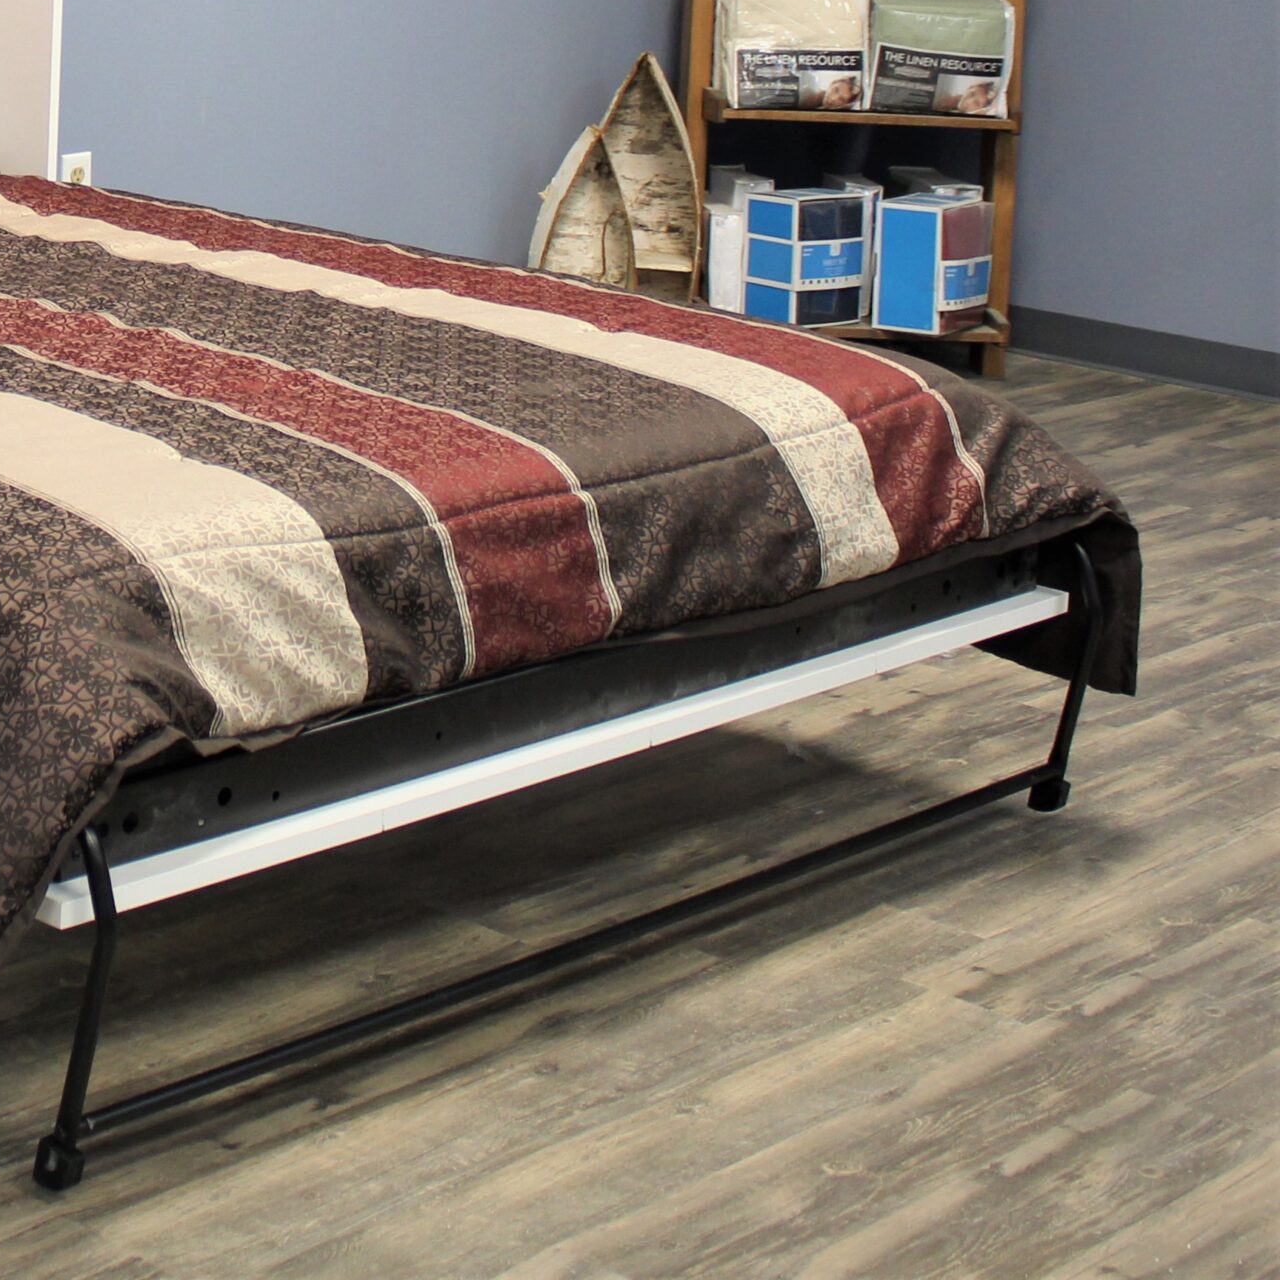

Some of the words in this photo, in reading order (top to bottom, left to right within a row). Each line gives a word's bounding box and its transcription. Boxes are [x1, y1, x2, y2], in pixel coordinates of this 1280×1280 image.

[884, 50, 906, 63] THE
[906, 54, 938, 67] LINEN
[940, 58, 998, 72] RESOURCE
